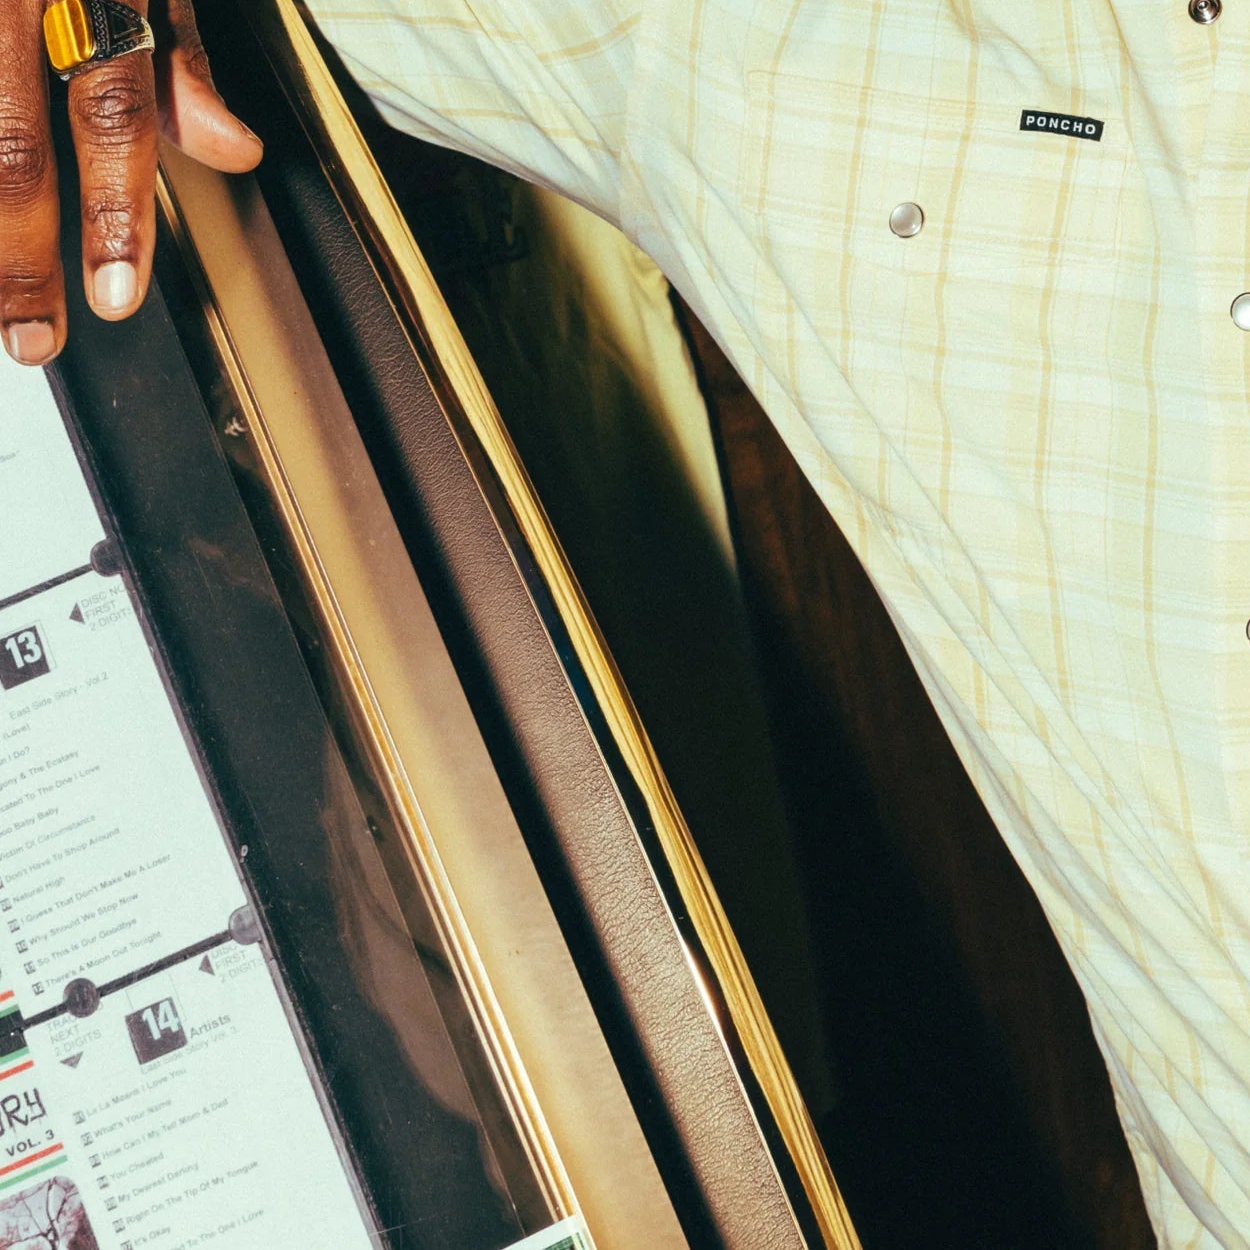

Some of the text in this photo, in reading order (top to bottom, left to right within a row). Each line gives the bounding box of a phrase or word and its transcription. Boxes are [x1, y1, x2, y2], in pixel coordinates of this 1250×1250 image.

[1026, 115, 1096, 135] PONCHO
[84, 600, 115, 620] FIRST
[5, 631, 42, 669] 13
[9, 706, 32, 720] East
[32, 698, 52, 710] Side
[54, 686, 78, 700] Story
[2, 723, 31, 740] (Love)
[13, 746, 29, 760] Do?
[28, 766, 45, 775] The
[45, 750, 78, 769] Ecstasy
[37, 785, 54, 795] The
[55, 777, 73, 788] One
[79, 765, 100, 777] Love
[13, 818, 35, 830] Baby
[37, 807, 58, 821] Baby
[5, 827, 120, 883] Don't Have To Shop Around
[13, 877, 65, 904] Natural High
[26, 907, 53, 922] Guess
[54, 897, 74, 909] That
[75, 886, 98, 901] Don't
[100, 876, 122, 889] Make
[124, 870, 136, 878] Me
[146, 854, 170, 869] Loser
[29, 934, 47, 945] Why
[49, 918, 81, 936] Should
[81, 913, 95, 922] We
[97, 903, 118, 916] Stop
[119, 893, 138, 905] Now
[37, 958, 50, 966] So
[51, 948, 70, 959] This
[81, 936, 97, 947] Our
[99, 918, 136, 939] Goodbye
[45, 970, 77, 987] There's
[86, 955, 111, 969] Moon
[112, 946, 128, 957] Out
[129, 931, 162, 948] Tonight
[50, 1024, 79, 1044] NEXT
[142, 999, 181, 1040] 14
[190, 1015, 231, 1038] Artists
[63, 1029, 102, 1052] DIGITS
[99, 1102, 111, 1111] La
[112, 1089, 140, 1104] Means
[146, 1076, 168, 1090] Love
[169, 1068, 187, 1078] You
[94, 1121, 124, 1138] What's
[125, 1111, 144, 1124] Your
[147, 1099, 171, 1113] Name
[102, 1147, 122, 1160] How
[123, 1139, 141, 1150] Can
[161, 1121, 177, 1132] Tell
[179, 1112, 200, 1125] Mom
[210, 1098, 228, 1111] Dad
[6, 1129, 54, 1156] VOL. 3
[109, 1152, 164, 1181] You Cheated
[118, 1194, 130, 1203] My
[132, 1177, 166, 1197] Dearest
[166, 1162, 199, 1181] Darling
[126, 1161, 258, 1225] Right On The Tip Of My Tongue
[149, 1227, 171, 1240] Okay
[199, 1230, 216, 1241] The
[217, 1222, 235, 1234] One
[242, 1210, 264, 1222] Love
